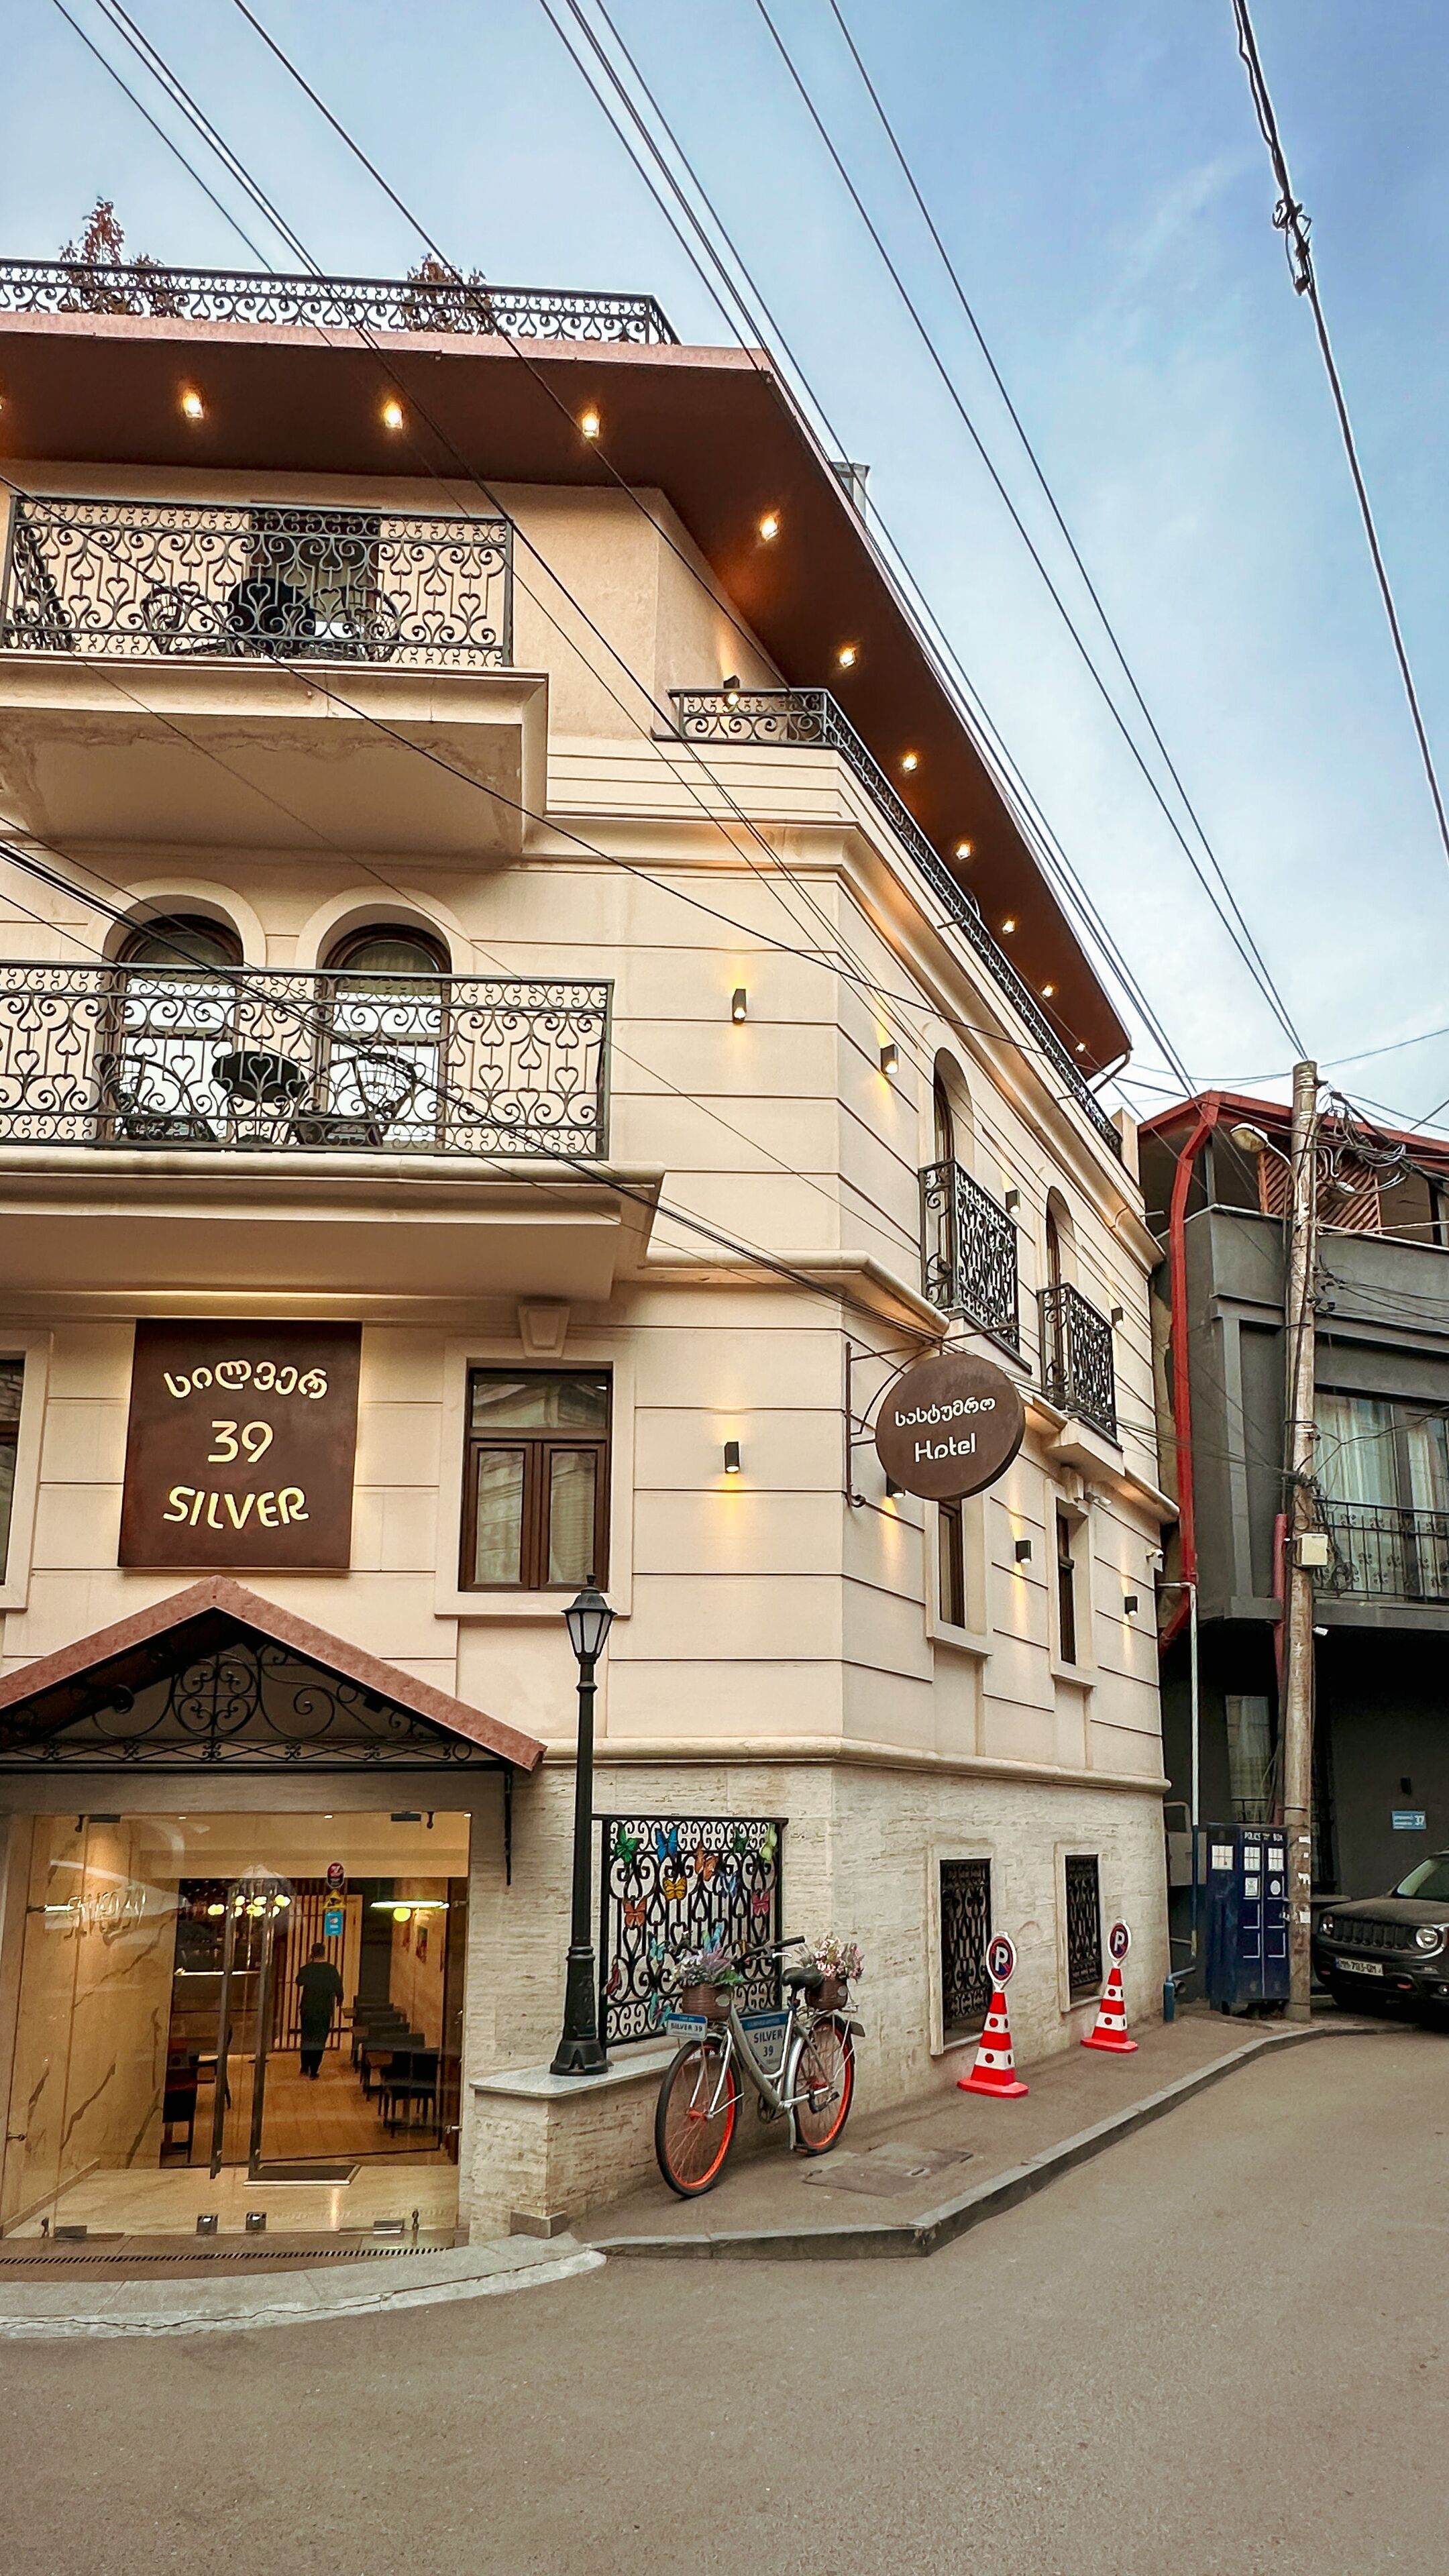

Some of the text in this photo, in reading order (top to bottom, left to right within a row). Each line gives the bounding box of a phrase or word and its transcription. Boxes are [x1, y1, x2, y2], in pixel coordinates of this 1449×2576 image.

[163, 1359, 328, 1399] სილვერ
[895, 1397, 996, 1427] სასტუმრო
[207, 1420, 274, 1463] 39
[914, 1432, 976, 1462] Hotel
[163, 1486, 309, 1529] SILVER
[1114, 1931, 1125, 1951] P
[995, 1945, 1009, 1971] P
[671, 2022, 703, 2033] SILVER 39
[753, 2029, 783, 2044] SILVER
[763, 2045, 773, 2057] 39
